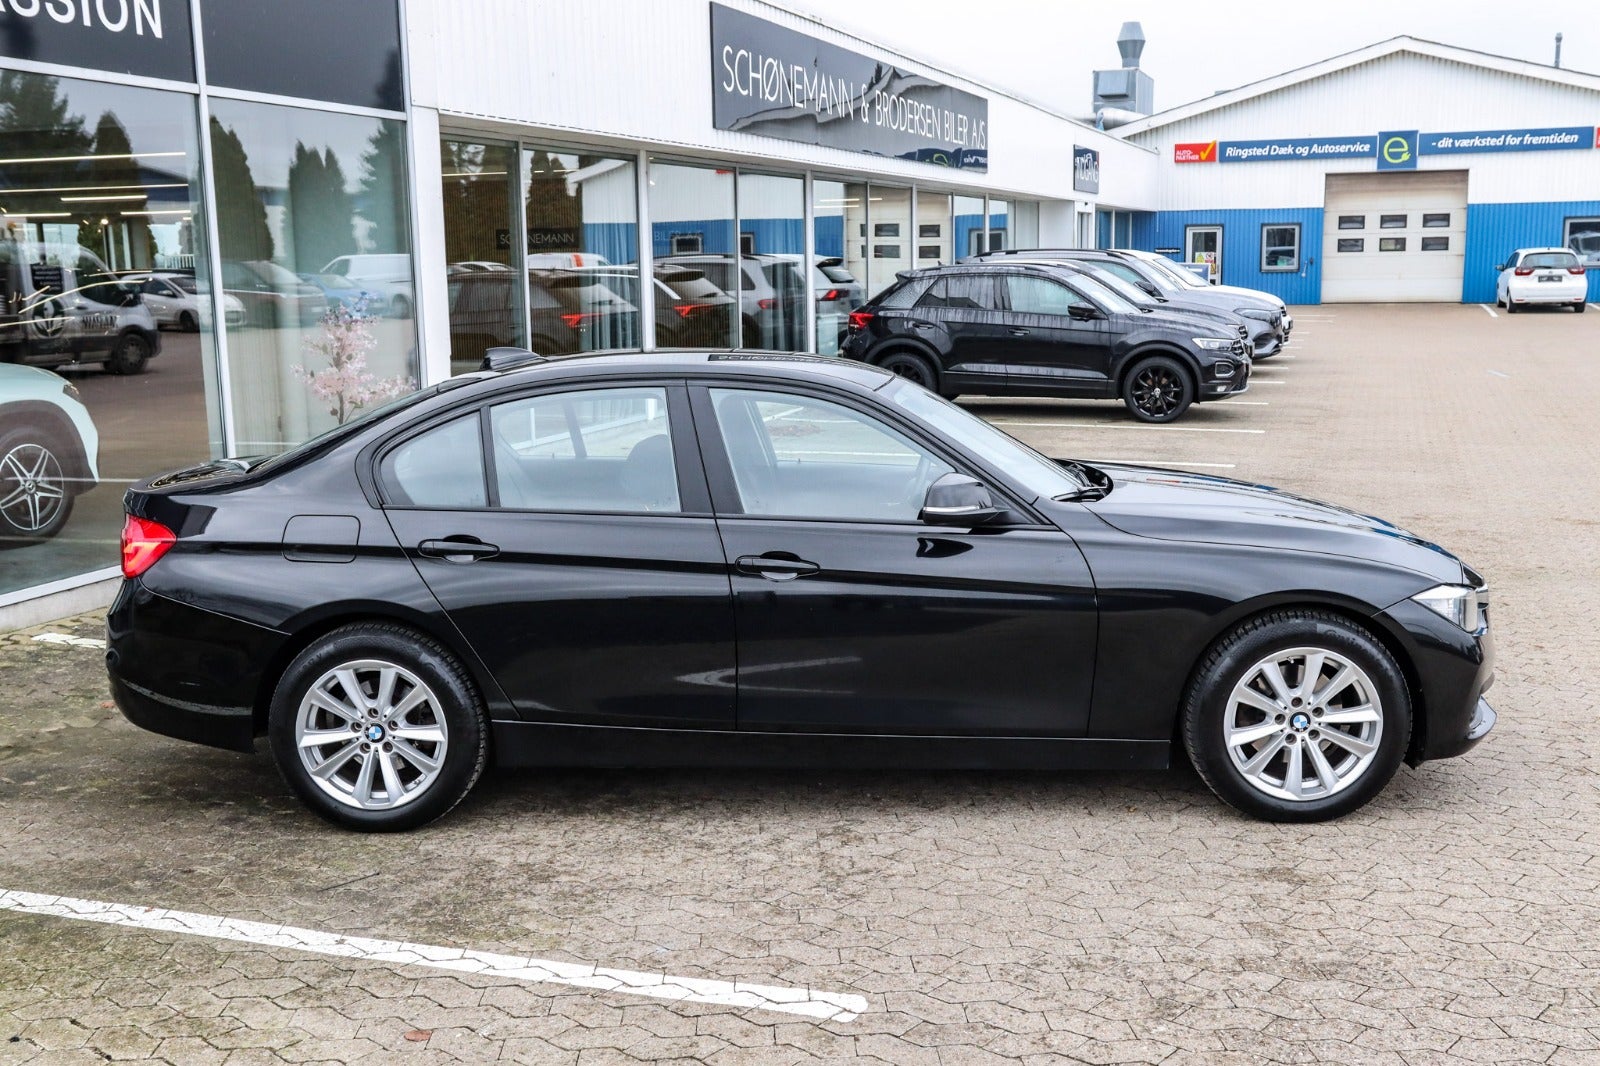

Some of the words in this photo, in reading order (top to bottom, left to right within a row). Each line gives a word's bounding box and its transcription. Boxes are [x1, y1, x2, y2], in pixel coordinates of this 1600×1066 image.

[722, 45, 854, 121] SCHØNEMANN
[860, 86, 870, 124] &
[875, 90, 941, 141] BRODERSEN
[944, 109, 969, 146] BILER
[971, 120, 986, 149] A/S
[1437, 137, 1453, 148] dit
[1454, 135, 1505, 147] værksted
[1505, 134, 1522, 146] for
[1523, 132, 1578, 145] fremtiden
[1225, 145, 1269, 158] Ringsted
[1270, 144, 1294, 155] Dæk
[1295, 146, 1309, 156] og
[1310, 142, 1371, 154] Autoservice
[500, 232, 575, 246] SCNEMANN
